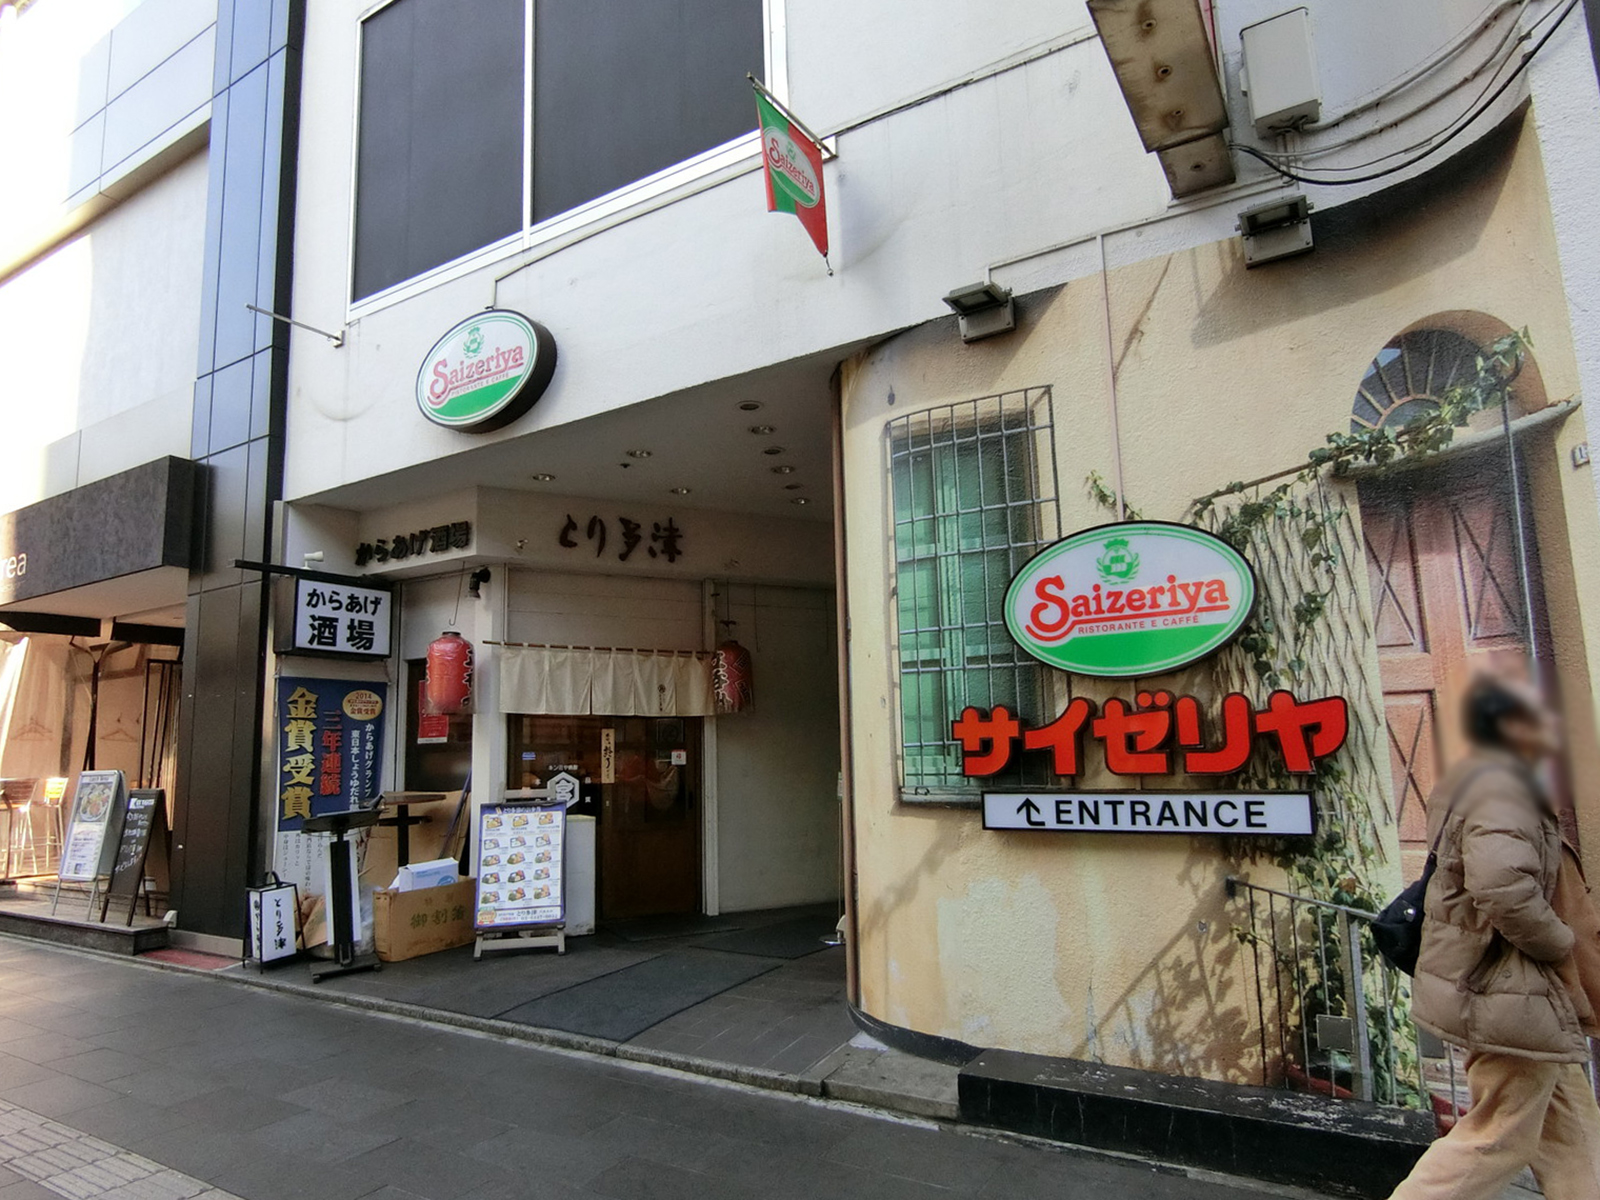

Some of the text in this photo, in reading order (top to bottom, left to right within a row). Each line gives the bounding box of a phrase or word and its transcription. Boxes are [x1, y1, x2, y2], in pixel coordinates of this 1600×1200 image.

[769, 137, 815, 196] Saizeriya
[428, 345, 525, 403] Saizeriya
[355, 520, 472, 567] からあげ酒場
[559, 514, 683, 562] とり多津
[306, 588, 382, 616] からあげ
[1026, 574, 1230, 641] Saizeriya
[1078, 621, 1145, 635] RISTORANTE
[1151, 619, 1158, 628] E
[308, 614, 375, 651] 酒場
[355, 692, 373, 700] 2014
[281, 686, 318, 819] 金賞受賞
[319, 709, 342, 795] 三年連続
[364, 723, 375, 798] からあげグランプ
[952, 690, 1348, 778] サイゼリヤ
[1055, 800, 1268, 829] ENTRANCE
